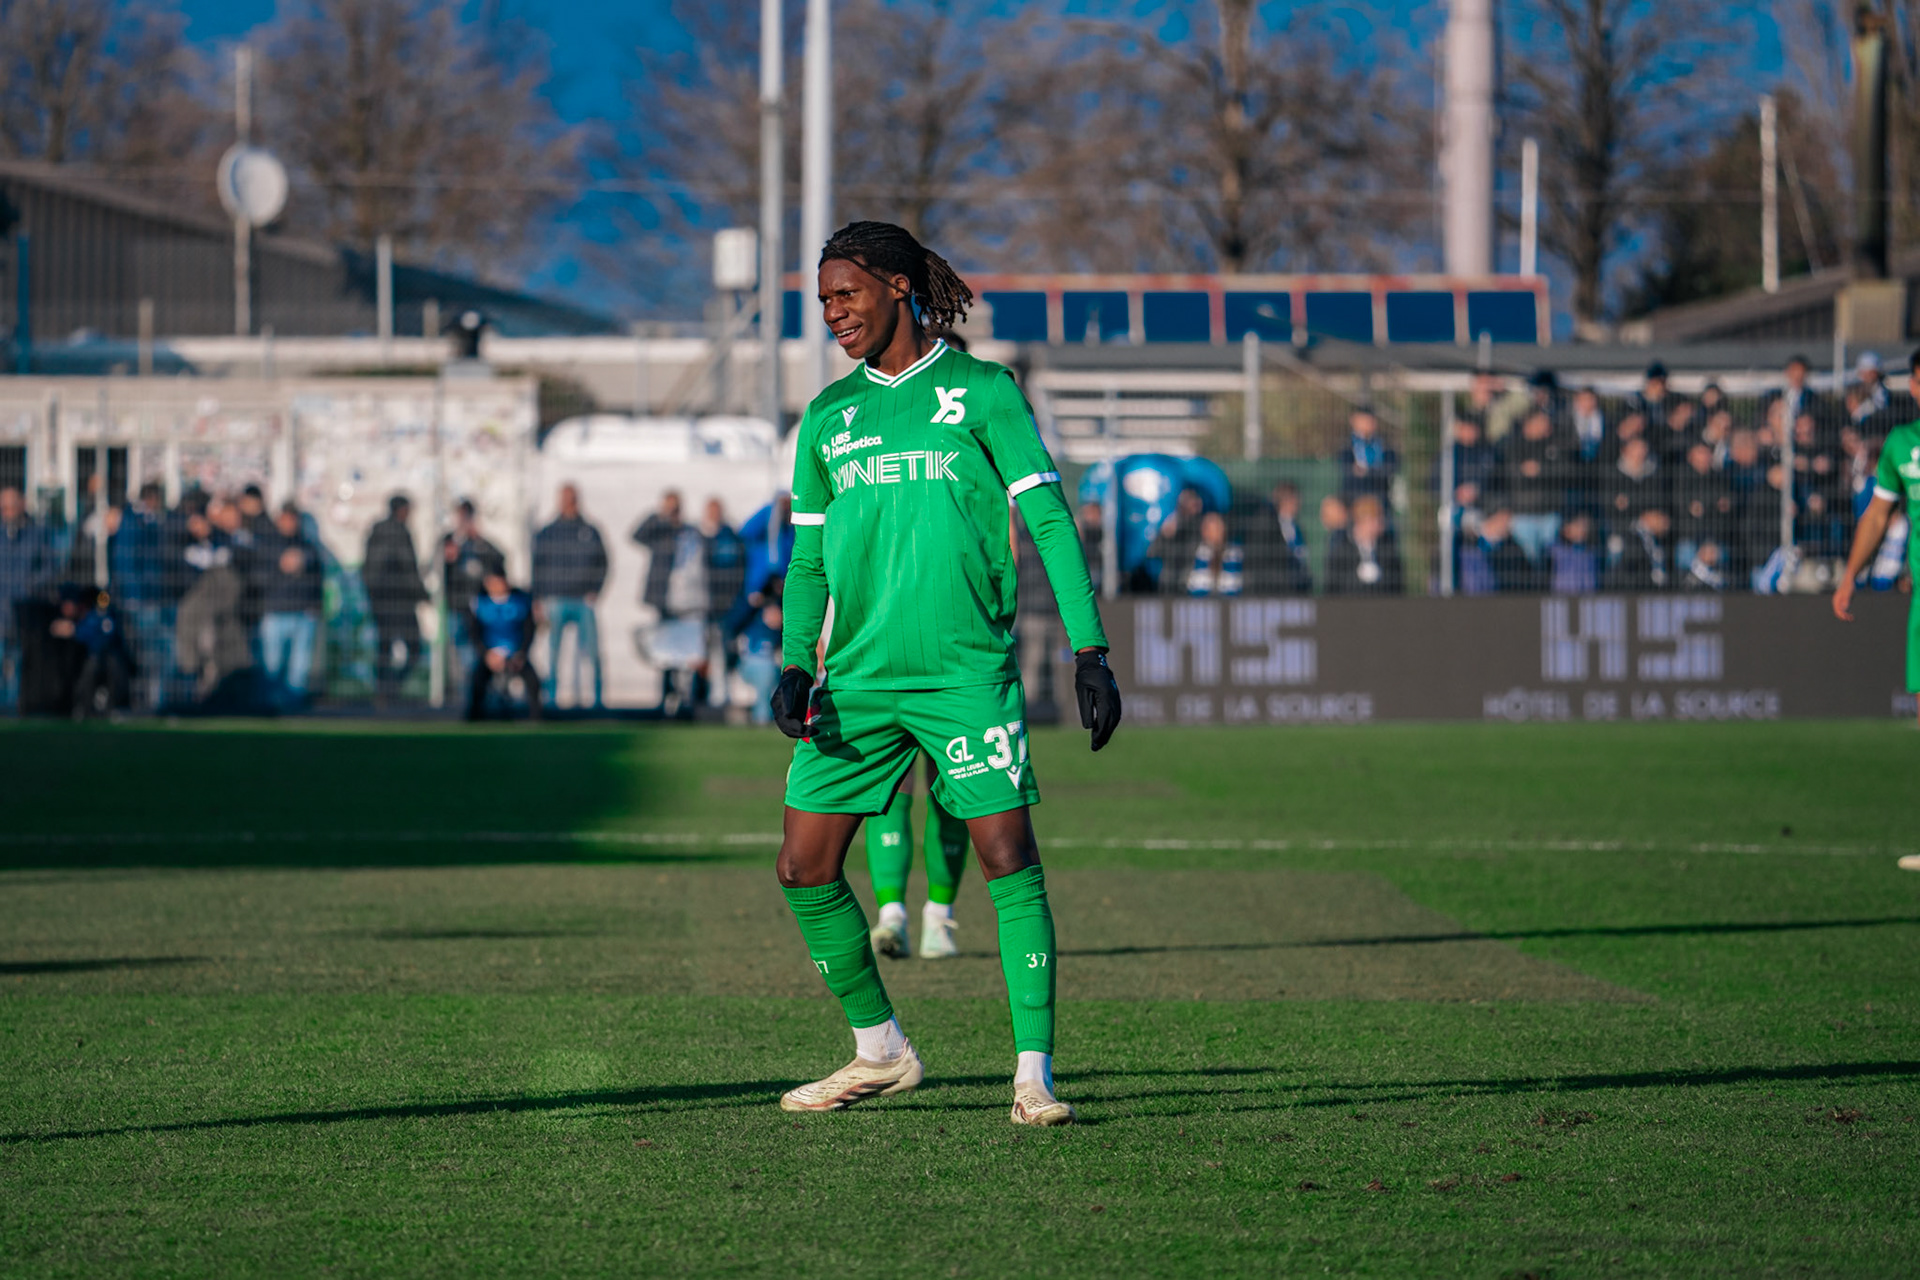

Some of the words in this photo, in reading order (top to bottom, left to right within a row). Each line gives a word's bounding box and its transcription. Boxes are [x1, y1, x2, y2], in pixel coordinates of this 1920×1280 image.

[831, 430, 851, 447] UBS
[831, 435, 883, 459] Helpetica
[1583, 691, 1618, 720] DE
[1631, 691, 1666, 720] LA
[983, 720, 1026, 770] 37
[813, 960, 829, 974] 7
[1026, 952, 1047, 969] 37
